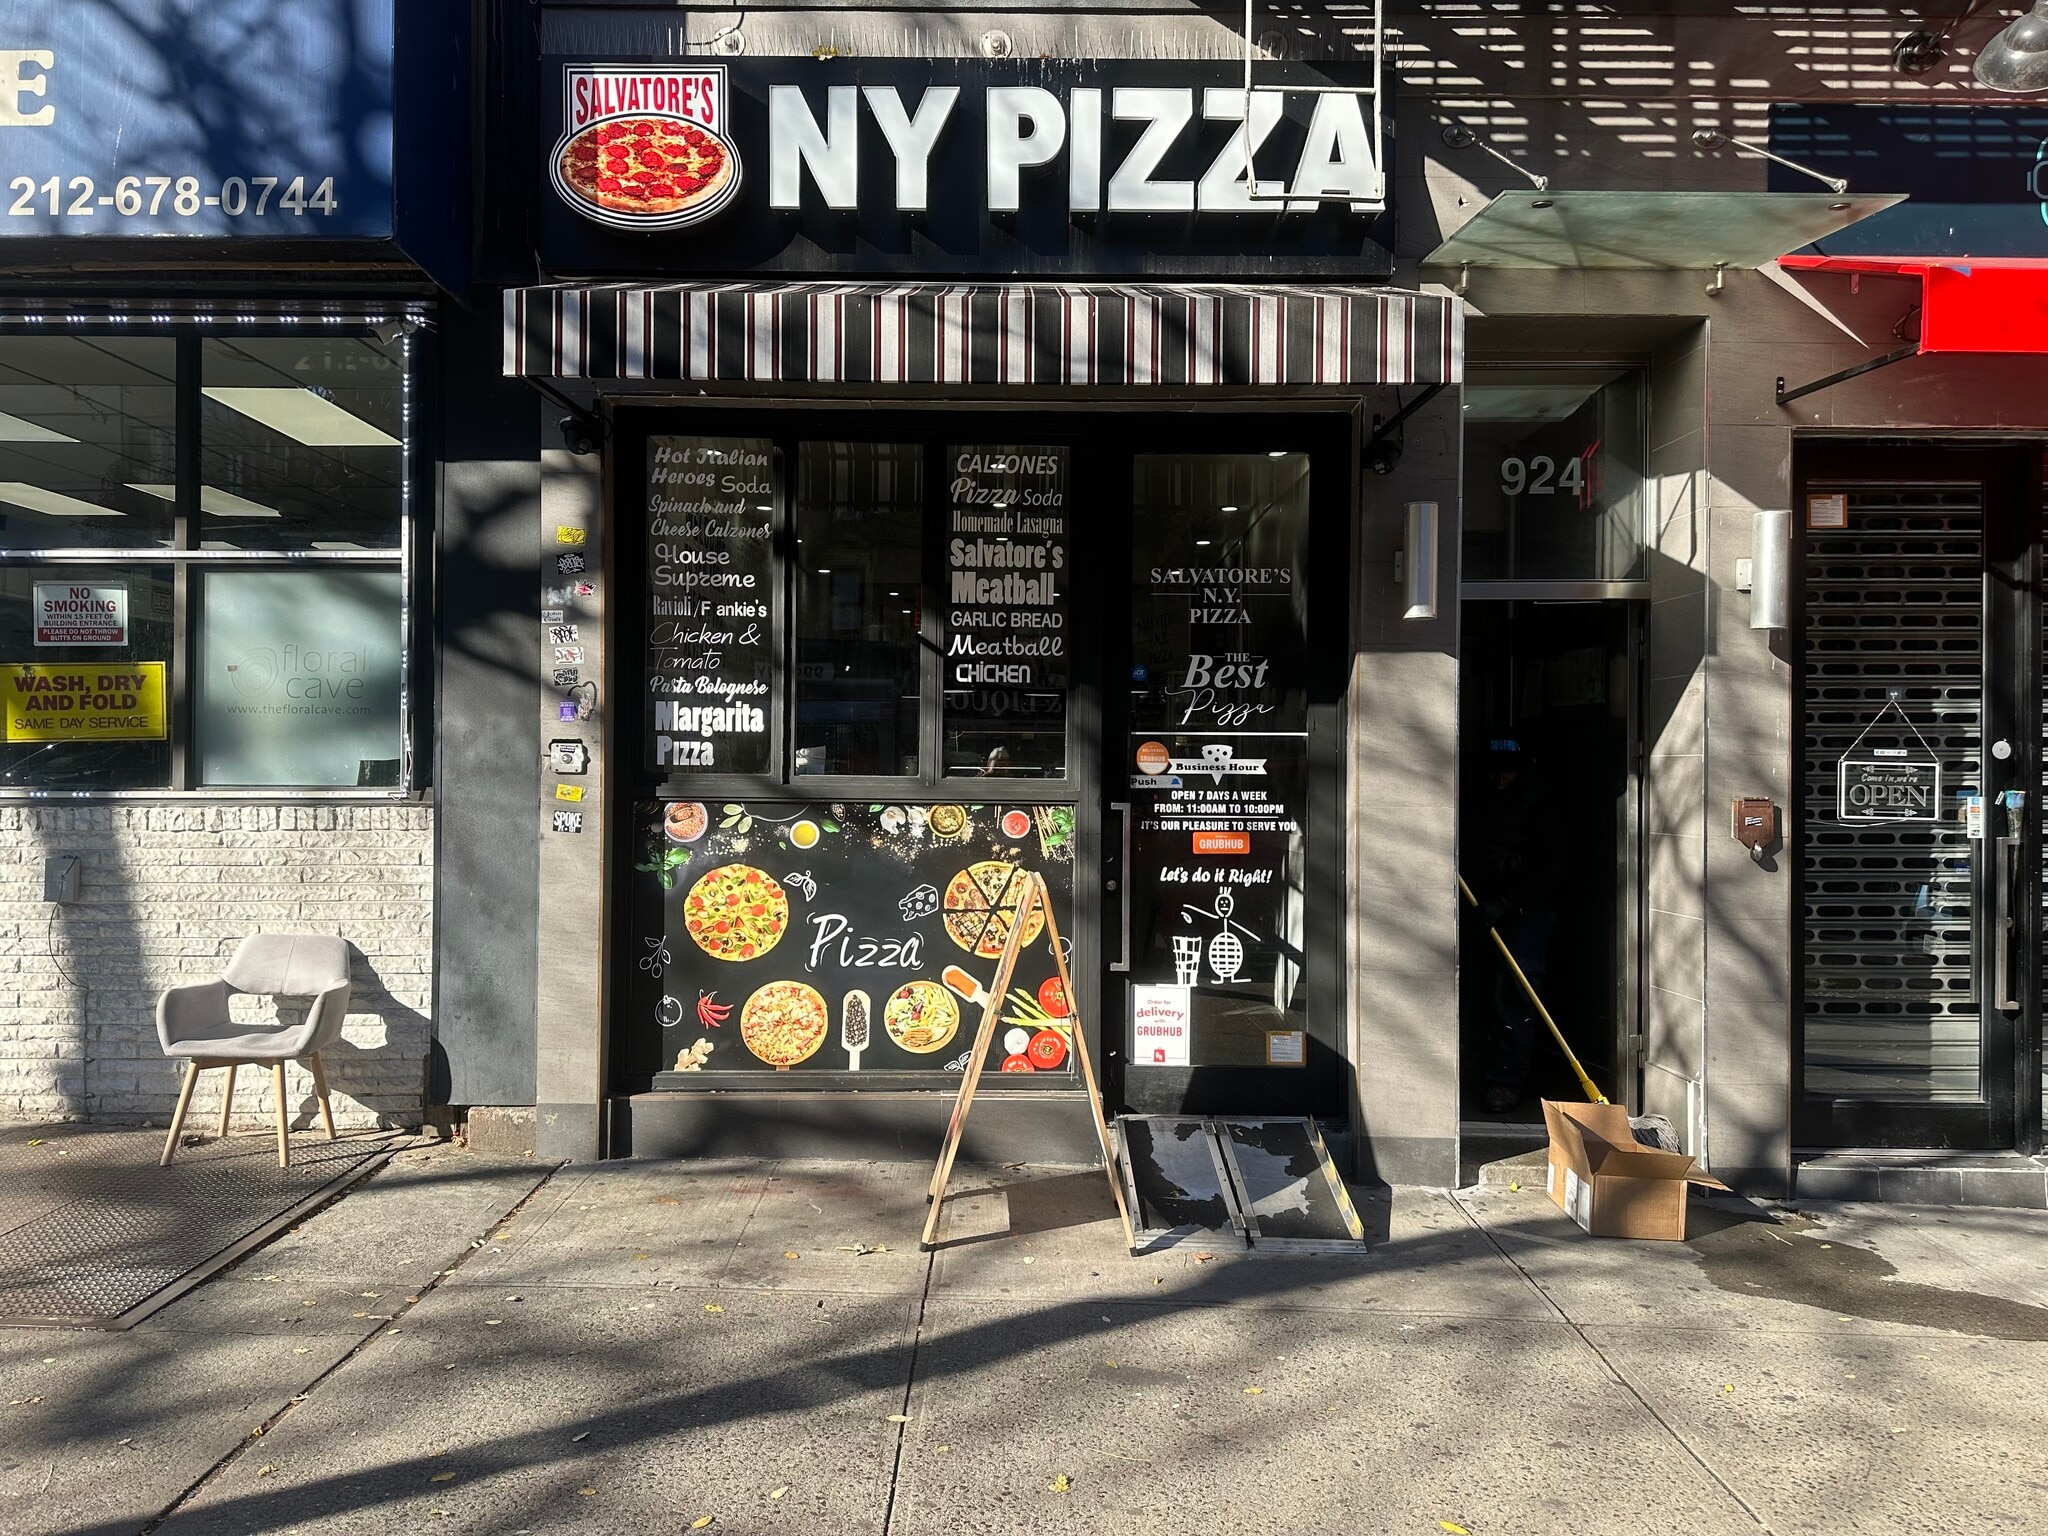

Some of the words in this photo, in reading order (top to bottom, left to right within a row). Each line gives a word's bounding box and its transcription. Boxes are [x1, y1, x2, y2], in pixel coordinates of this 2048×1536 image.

[575, 77, 714, 125] SALVATORE'S
[769, 85, 960, 210] NY
[986, 86, 1386, 214] PIZZA
[8, 176, 338, 216] 212-678-0744
[655, 447, 691, 463] Hot
[697, 448, 767, 466] Italian
[957, 454, 1058, 475] CALZONES
[651, 467, 715, 487] Heroes
[721, 475, 772, 494] Soda
[1501, 456, 1585, 496] 924
[950, 477, 1021, 504] Pizza
[1023, 488, 1063, 506] Soda
[648, 494, 714, 517] Spinach
[714, 498, 746, 514] and
[650, 518, 700, 537] Cheese
[705, 519, 773, 539] Calzones
[953, 510, 1014, 533] Homemade
[1017, 511, 1063, 538] Lasagna
[655, 543, 730, 565] House
[950, 538, 1064, 569] Salvatore's
[655, 565, 756, 593] Supreme
[1150, 568, 1291, 584] SALVATORE'S
[69, 587, 91, 600] NO
[952, 571, 1055, 606] Meatball
[1202, 588, 1241, 603] N.Y.
[44, 600, 117, 613] SMOKING
[1189, 608, 1252, 624] PIZZA
[951, 611, 1007, 627] GARLIC
[1010, 612, 1063, 628] BREAD
[650, 621, 733, 645] Chicken
[739, 623, 761, 646] &
[947, 634, 1064, 657] Meatball
[282, 644, 366, 673] floral
[650, 646, 723, 669] Tomato
[1225, 652, 1250, 662] THE
[1180, 655, 1269, 689] Best
[14, 675, 92, 695] WASH,
[98, 674, 147, 691] DRY
[286, 676, 365, 700] cave
[650, 675, 694, 693] Pasta
[695, 675, 769, 703] Bolognese
[25, 694, 77, 711] AND
[83, 693, 138, 710] FOLD
[227, 703, 371, 716] www.thefloralcave.com
[1165, 686, 1275, 726] Pizza
[14, 717, 54, 729] SAME
[60, 717, 84, 729] DAY
[88, 716, 149, 728] SERVICE
[655, 701, 764, 737] Margarita
[1176, 763, 1226, 771] Business
[1229, 763, 1259, 771] Hour
[1131, 777, 1157, 786] Push
[1171, 790, 1196, 800] OPEN
[1198, 790, 1203, 800] 7
[1207, 790, 1230, 800] DAYS
[1232, 791, 1239, 800] A
[1241, 791, 1268, 801] WEEK
[1849, 784, 1930, 807] OPEN
[553, 811, 582, 828] SPOKE
[1154, 804, 1184, 813] FROM:
[1186, 804, 1227, 813] 11:00AM
[1229, 804, 1241, 813] TO
[1243, 804, 1284, 814] 10:00PM
[1141, 821, 1159, 830] IT'S
[1161, 821, 1181, 830] OUR
[1182, 821, 1230, 831] PLEASURE
[1232, 821, 1244, 831] TO
[1246, 821, 1276, 831] SERVE
[1278, 821, 1297, 831] YOU
[1199, 838, 1244, 849] GRUBHUB
[1160, 867, 1189, 883] Let's
[1191, 867, 1211, 882] do
[1214, 868, 1225, 883] it
[1228, 868, 1273, 887] Right!
[809, 913, 921, 968] Pizza
[1136, 1006, 1184, 1021] delivery
[1137, 1025, 1183, 1036] GRUBHUB
